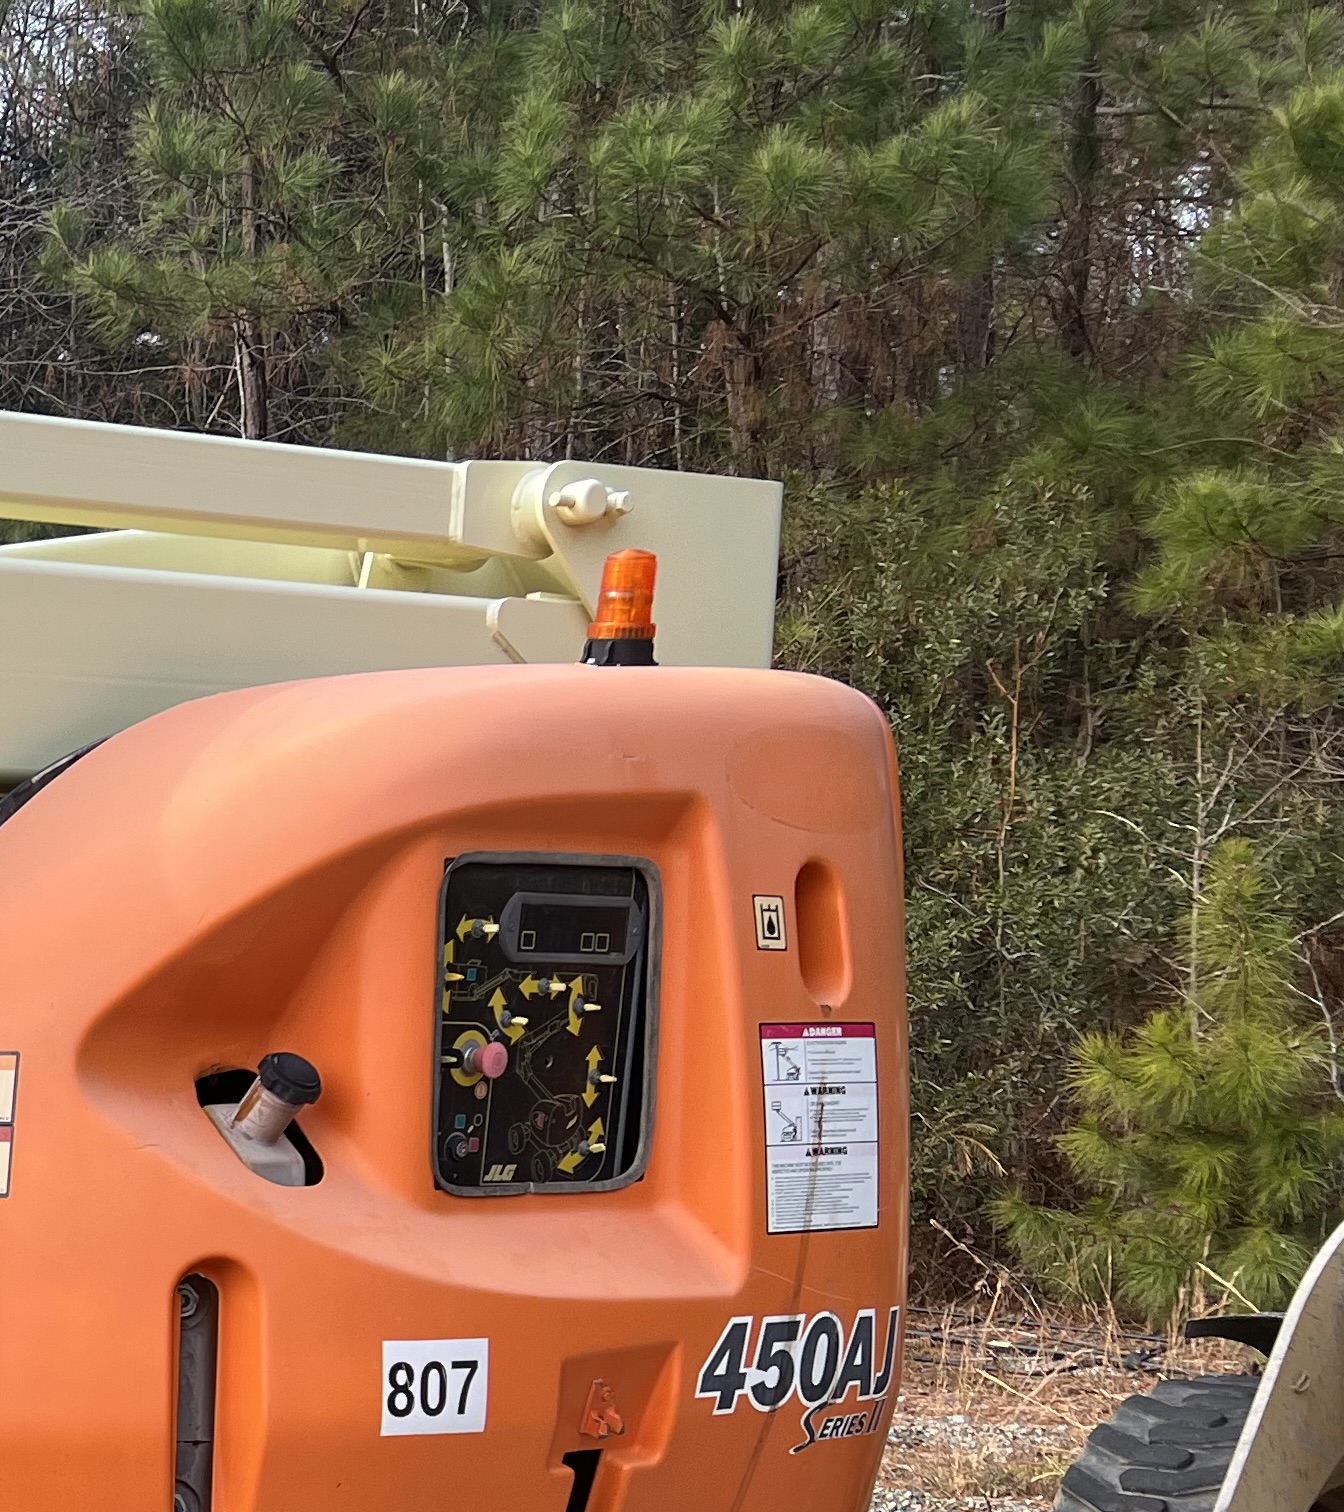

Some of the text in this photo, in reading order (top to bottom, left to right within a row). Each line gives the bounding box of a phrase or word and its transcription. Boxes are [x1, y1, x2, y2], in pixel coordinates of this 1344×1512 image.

[808, 1027, 842, 1037] DANGER
[810, 1086, 846, 1095] WARNING
[811, 1146, 848, 1156] WARNING
[483, 1164, 518, 1182] JLG
[695, 1305, 900, 1416] 450AJ
[387, 1360, 479, 1418] 807
